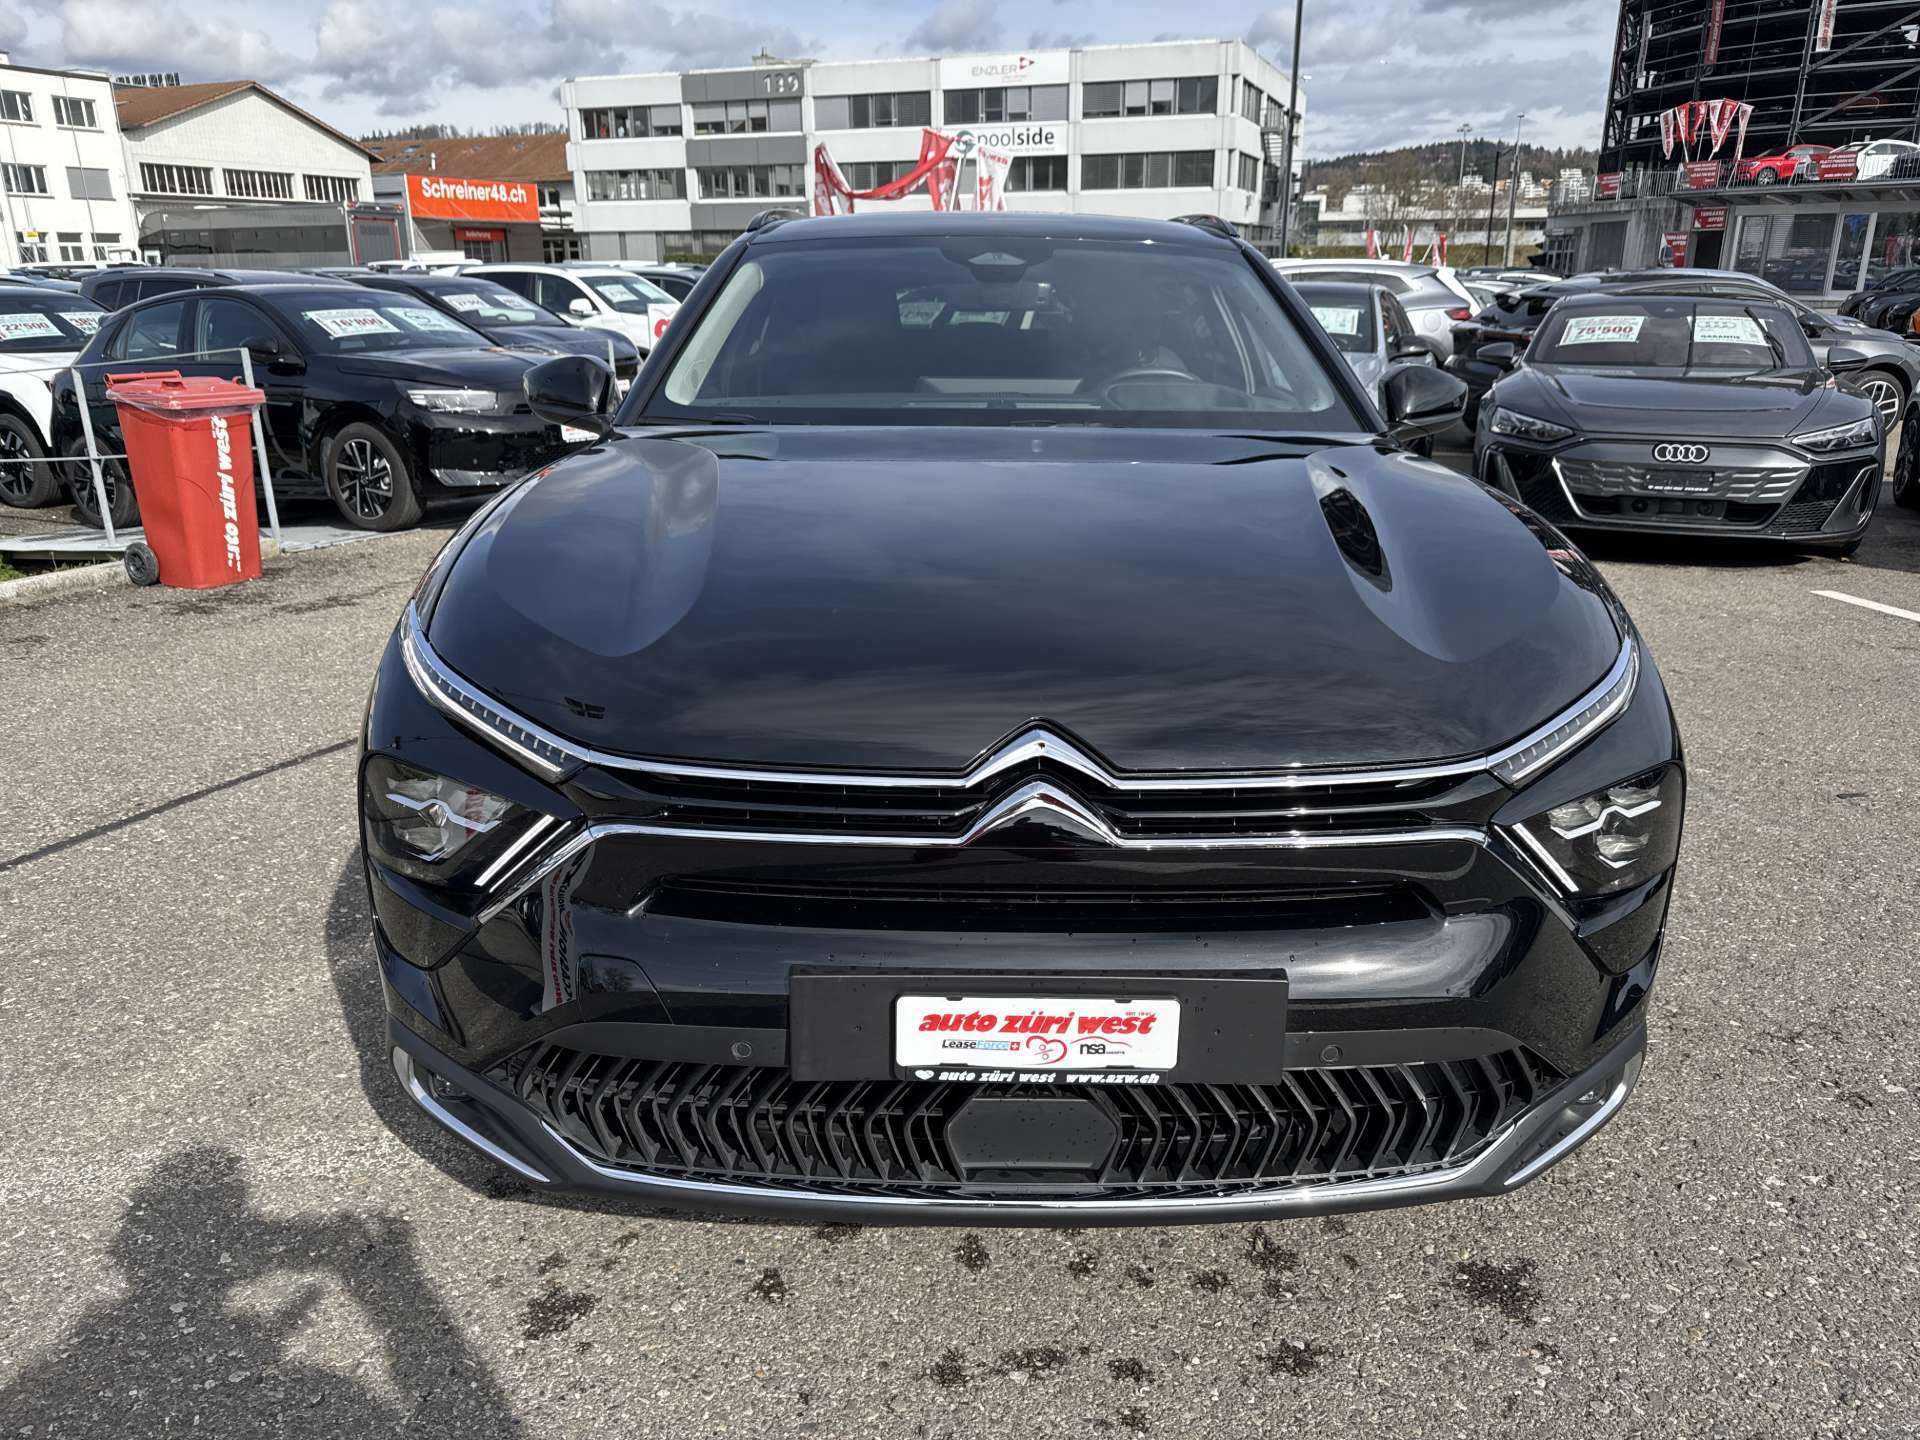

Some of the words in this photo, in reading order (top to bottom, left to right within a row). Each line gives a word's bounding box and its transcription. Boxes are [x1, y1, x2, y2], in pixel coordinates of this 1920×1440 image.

[971, 64, 1018, 77] ENZLER
[421, 177, 528, 204] Schreiner48.ch
[1576, 325, 1634, 335] 75'500
[918, 1011, 998, 1032] auto
[998, 1011, 1075, 1034] züri
[1077, 1012, 1158, 1034] west
[941, 1039, 1009, 1051] LeaseForce
[1079, 1043, 1106, 1055] nsa
[938, 1070, 976, 1081] auto
[979, 1069, 1014, 1082] züri
[1018, 1072, 1057, 1083] west
[1066, 1073, 1160, 1084] www.azw.ch
